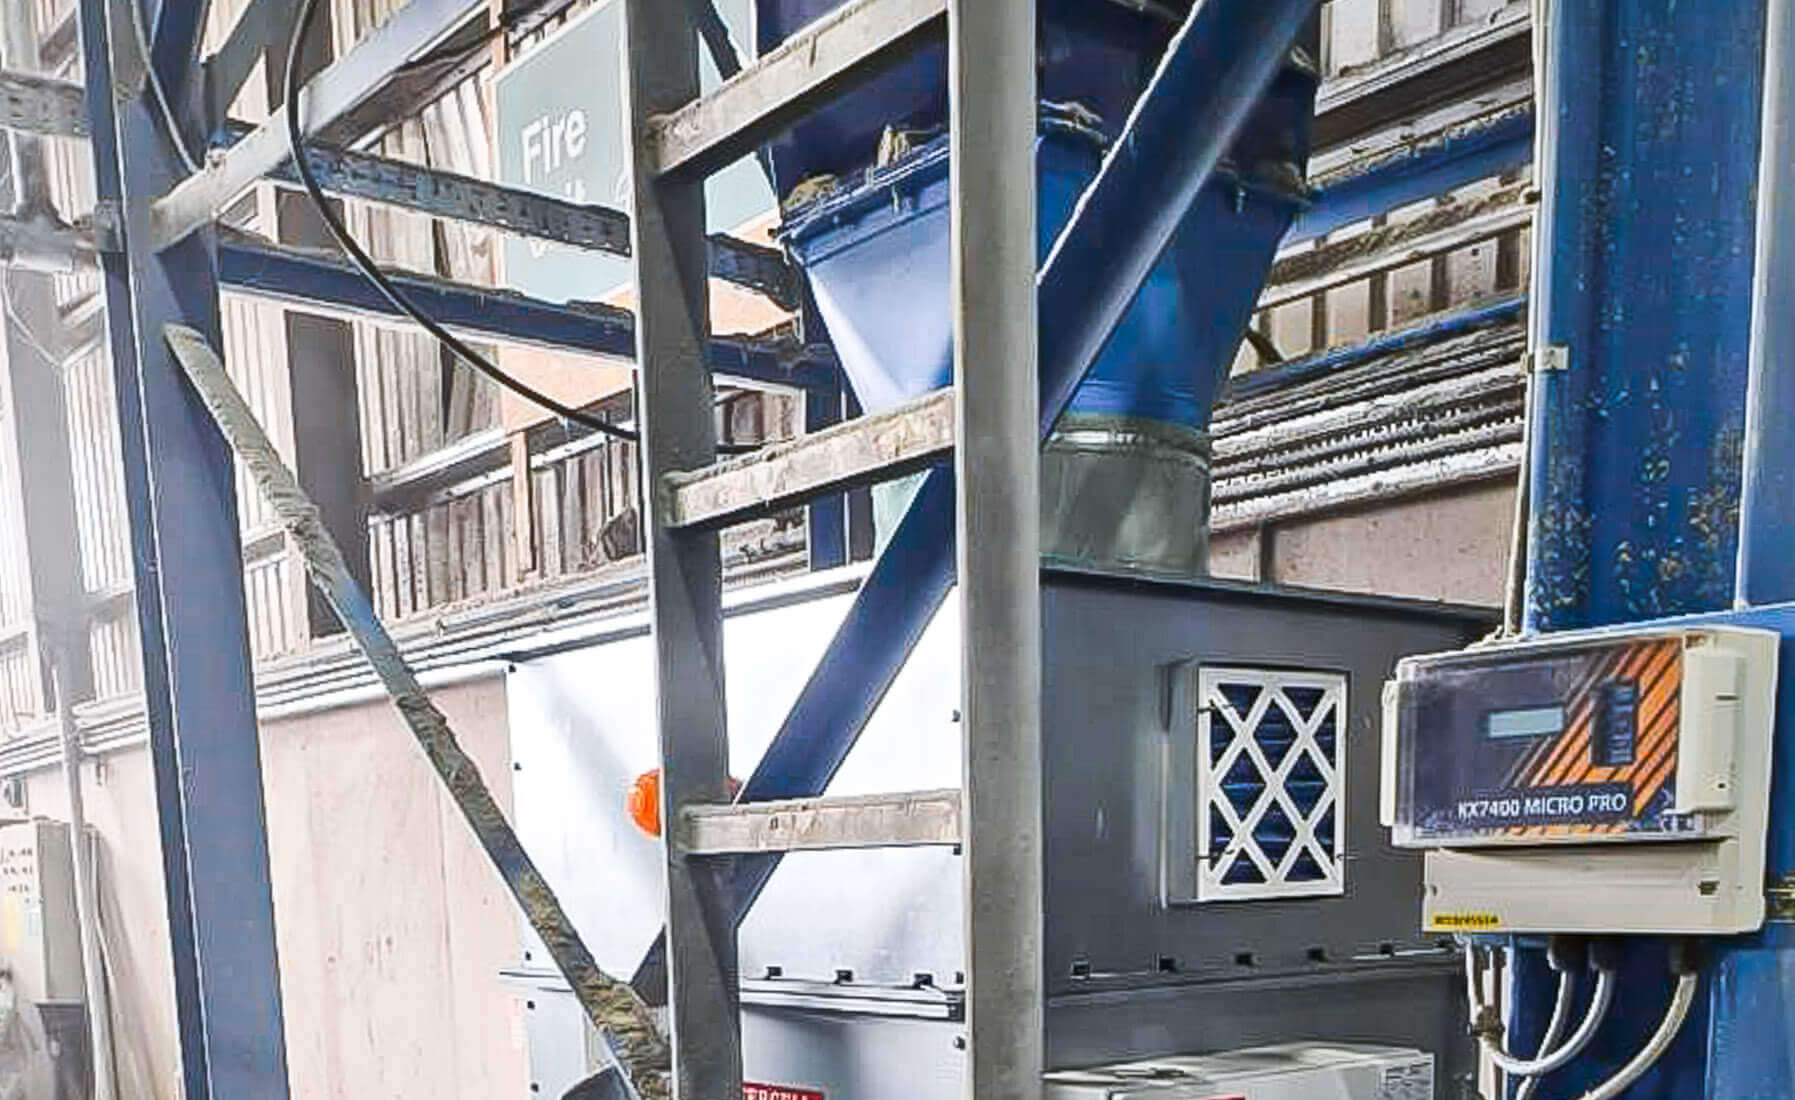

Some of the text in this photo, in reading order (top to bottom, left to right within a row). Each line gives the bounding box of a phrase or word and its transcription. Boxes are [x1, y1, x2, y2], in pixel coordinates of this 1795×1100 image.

[521, 109, 587, 184] Fire
[1524, 796, 1584, 816] MICRO
[1587, 793, 1627, 812] PRO
